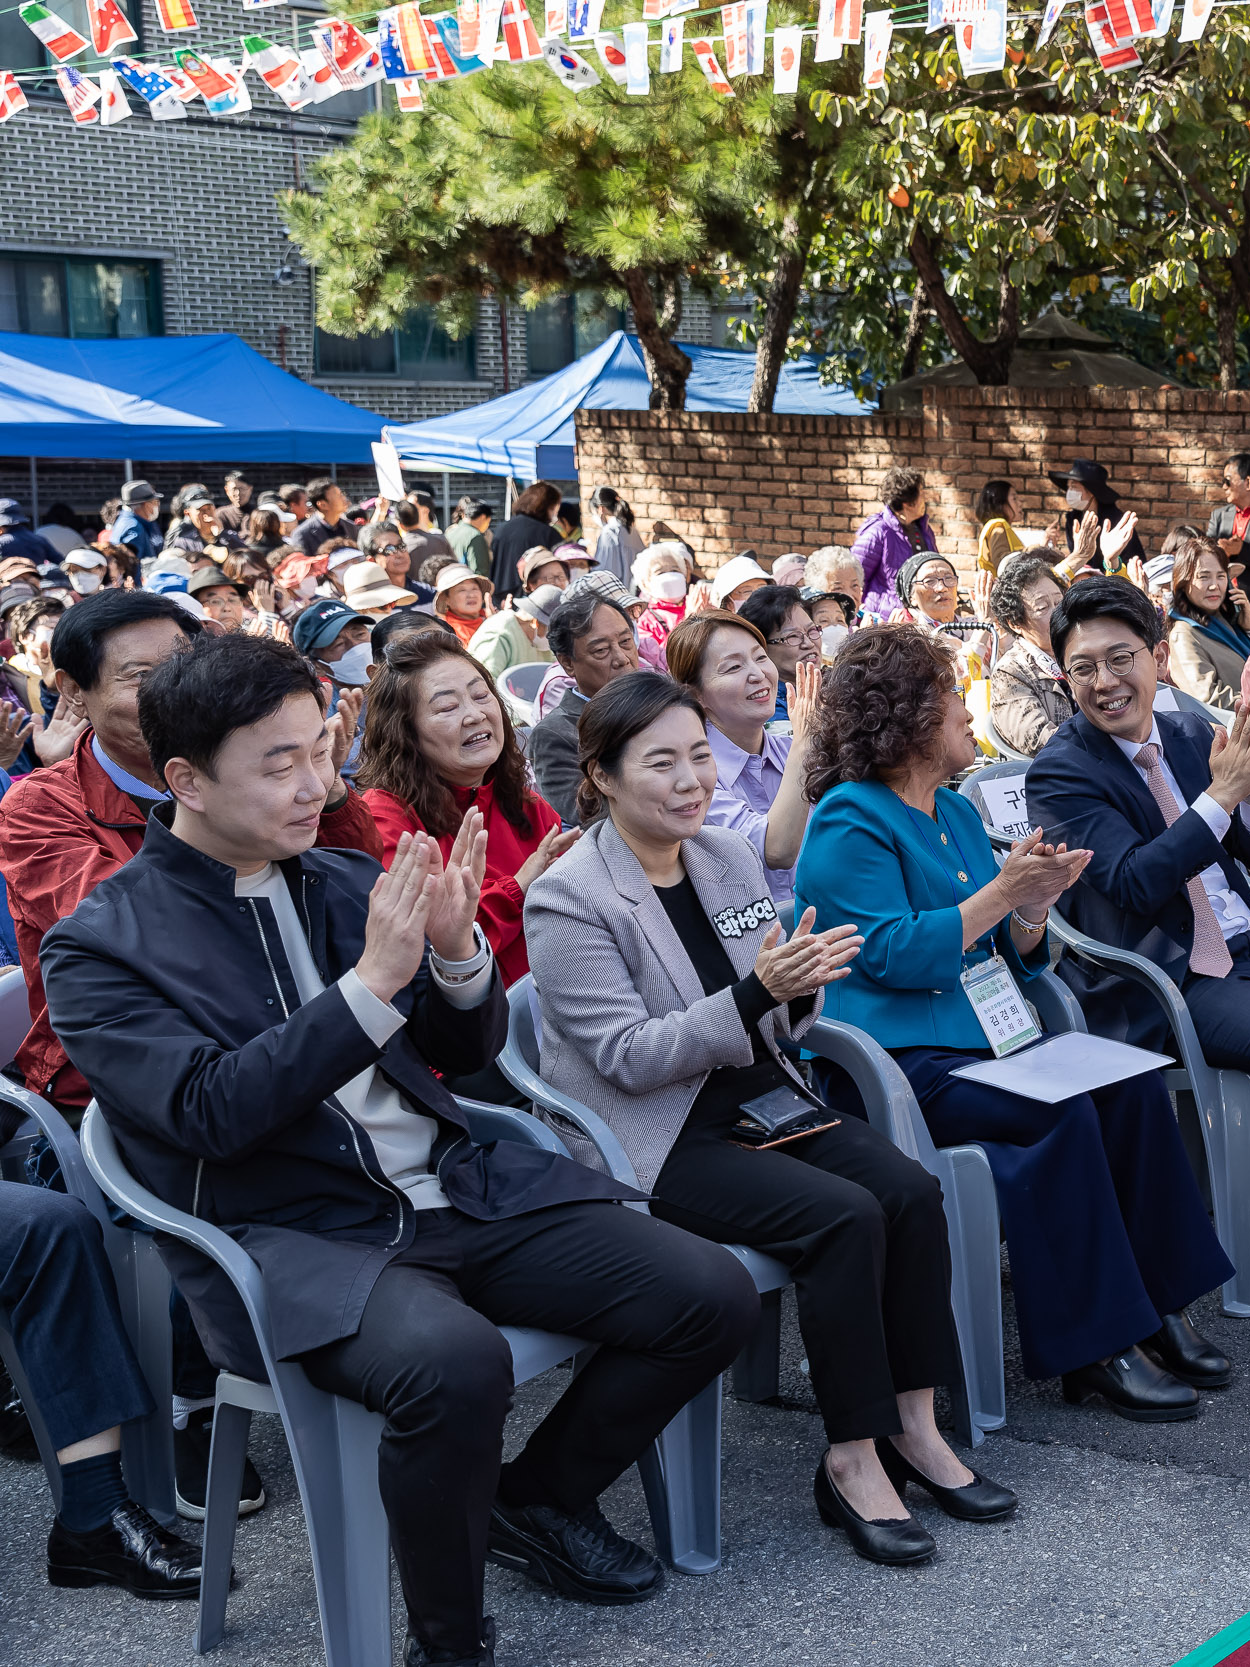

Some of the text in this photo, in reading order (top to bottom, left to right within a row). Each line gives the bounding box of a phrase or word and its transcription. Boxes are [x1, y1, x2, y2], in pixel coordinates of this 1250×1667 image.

[319, 606, 346, 620] FILA
[713, 907, 736, 923] 시의원
[717, 898, 775, 937] 박성연
